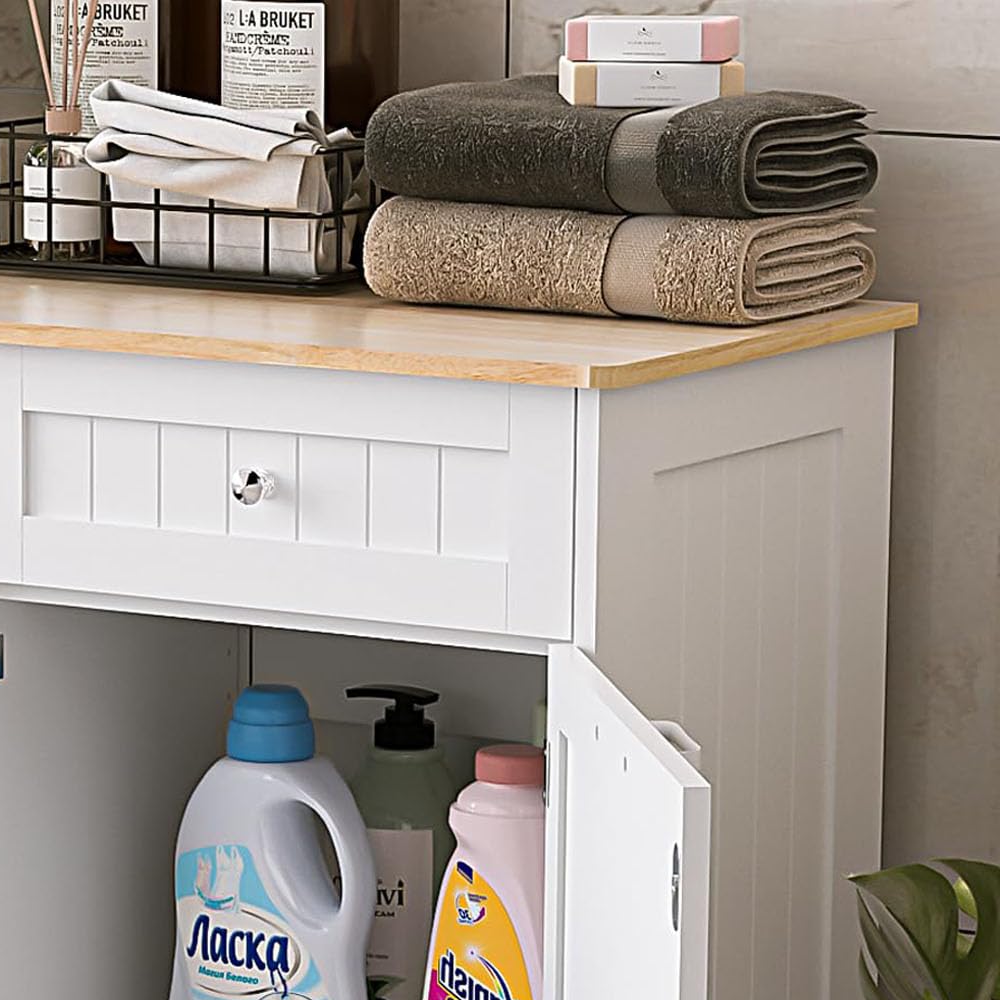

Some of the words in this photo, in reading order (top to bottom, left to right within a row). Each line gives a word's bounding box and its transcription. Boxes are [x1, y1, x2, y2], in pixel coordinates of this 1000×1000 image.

[95, 3, 149, 21] BRUKET
[239, 9, 256, 27] L:A
[259, 11, 316, 29] BRUKET
[187, 914, 290, 974] Ласка
